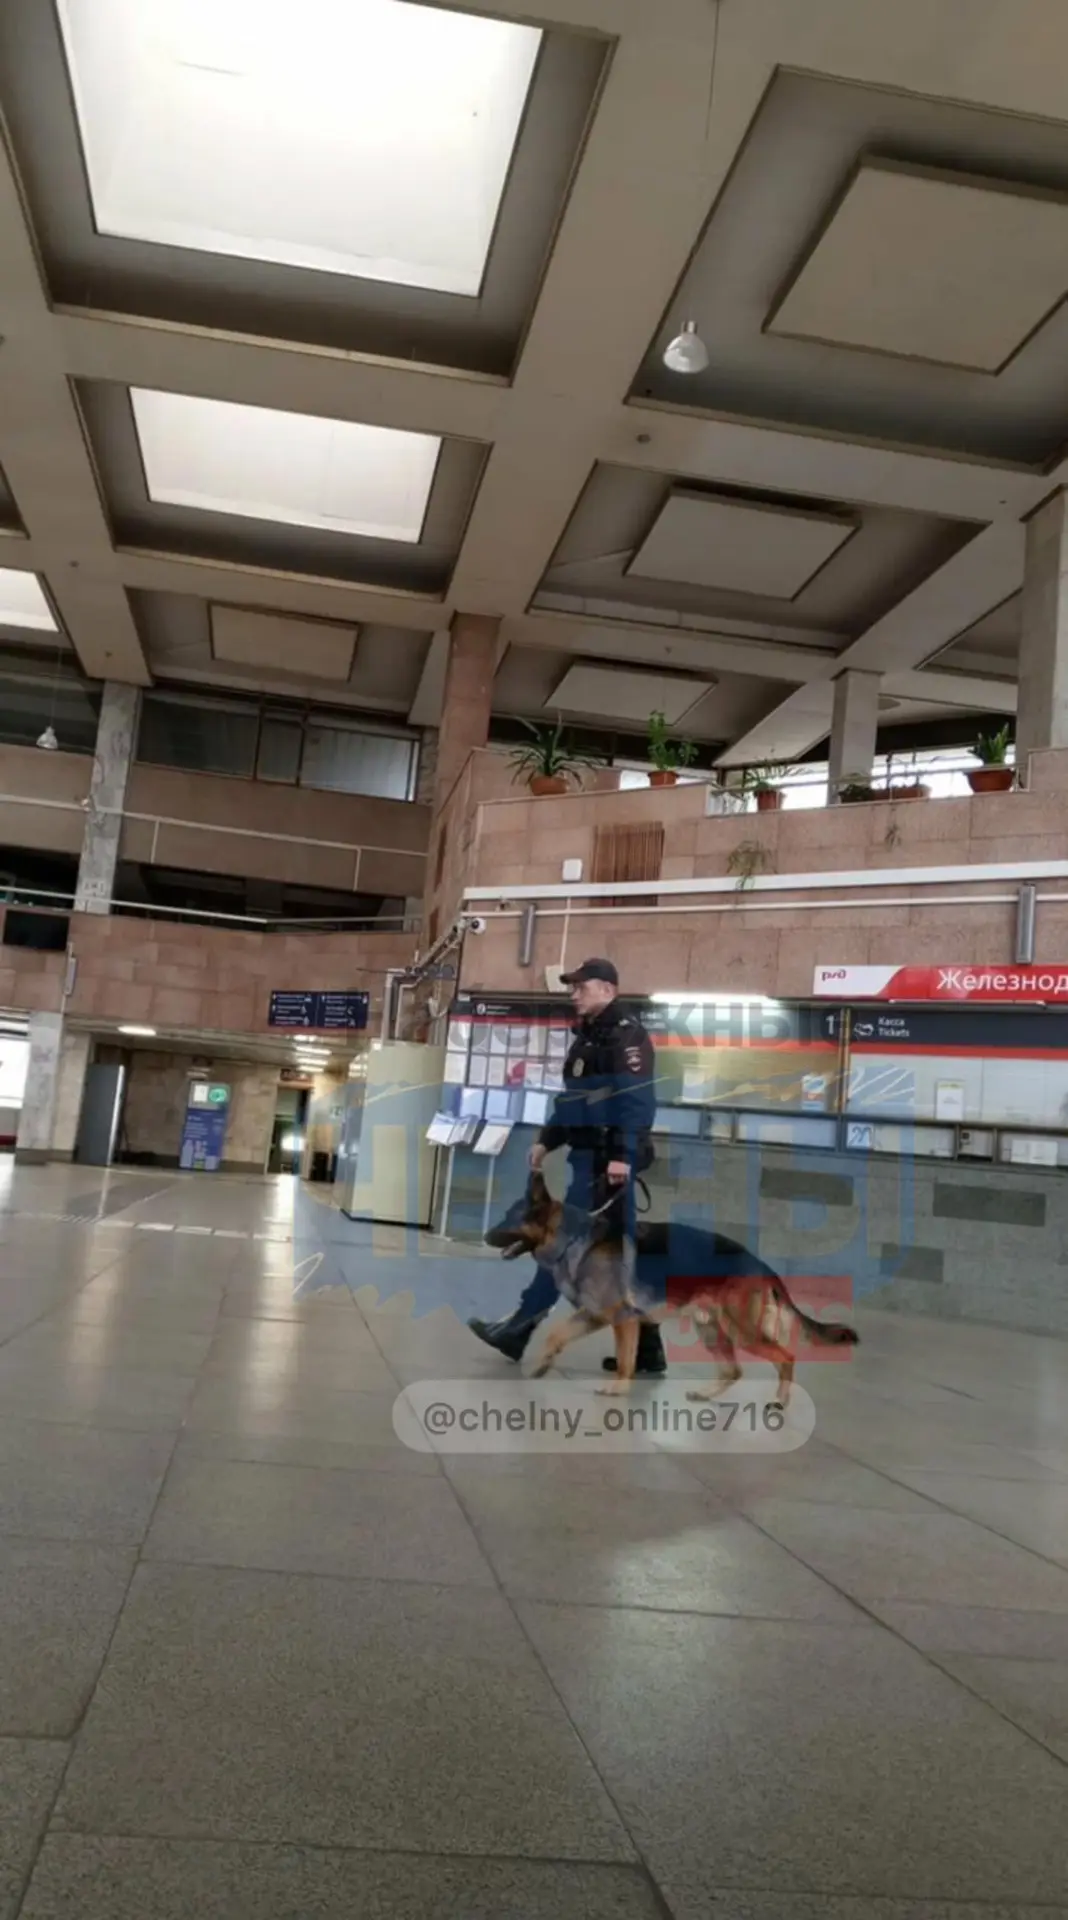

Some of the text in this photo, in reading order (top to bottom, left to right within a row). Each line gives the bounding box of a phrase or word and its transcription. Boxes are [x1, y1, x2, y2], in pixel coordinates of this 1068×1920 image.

[936, 969, 1068, 993] Железнод
[825, 1015, 835, 1035] 1
[878, 1016, 905, 1026] Касса
[878, 1027, 910, 1037] Tickets
